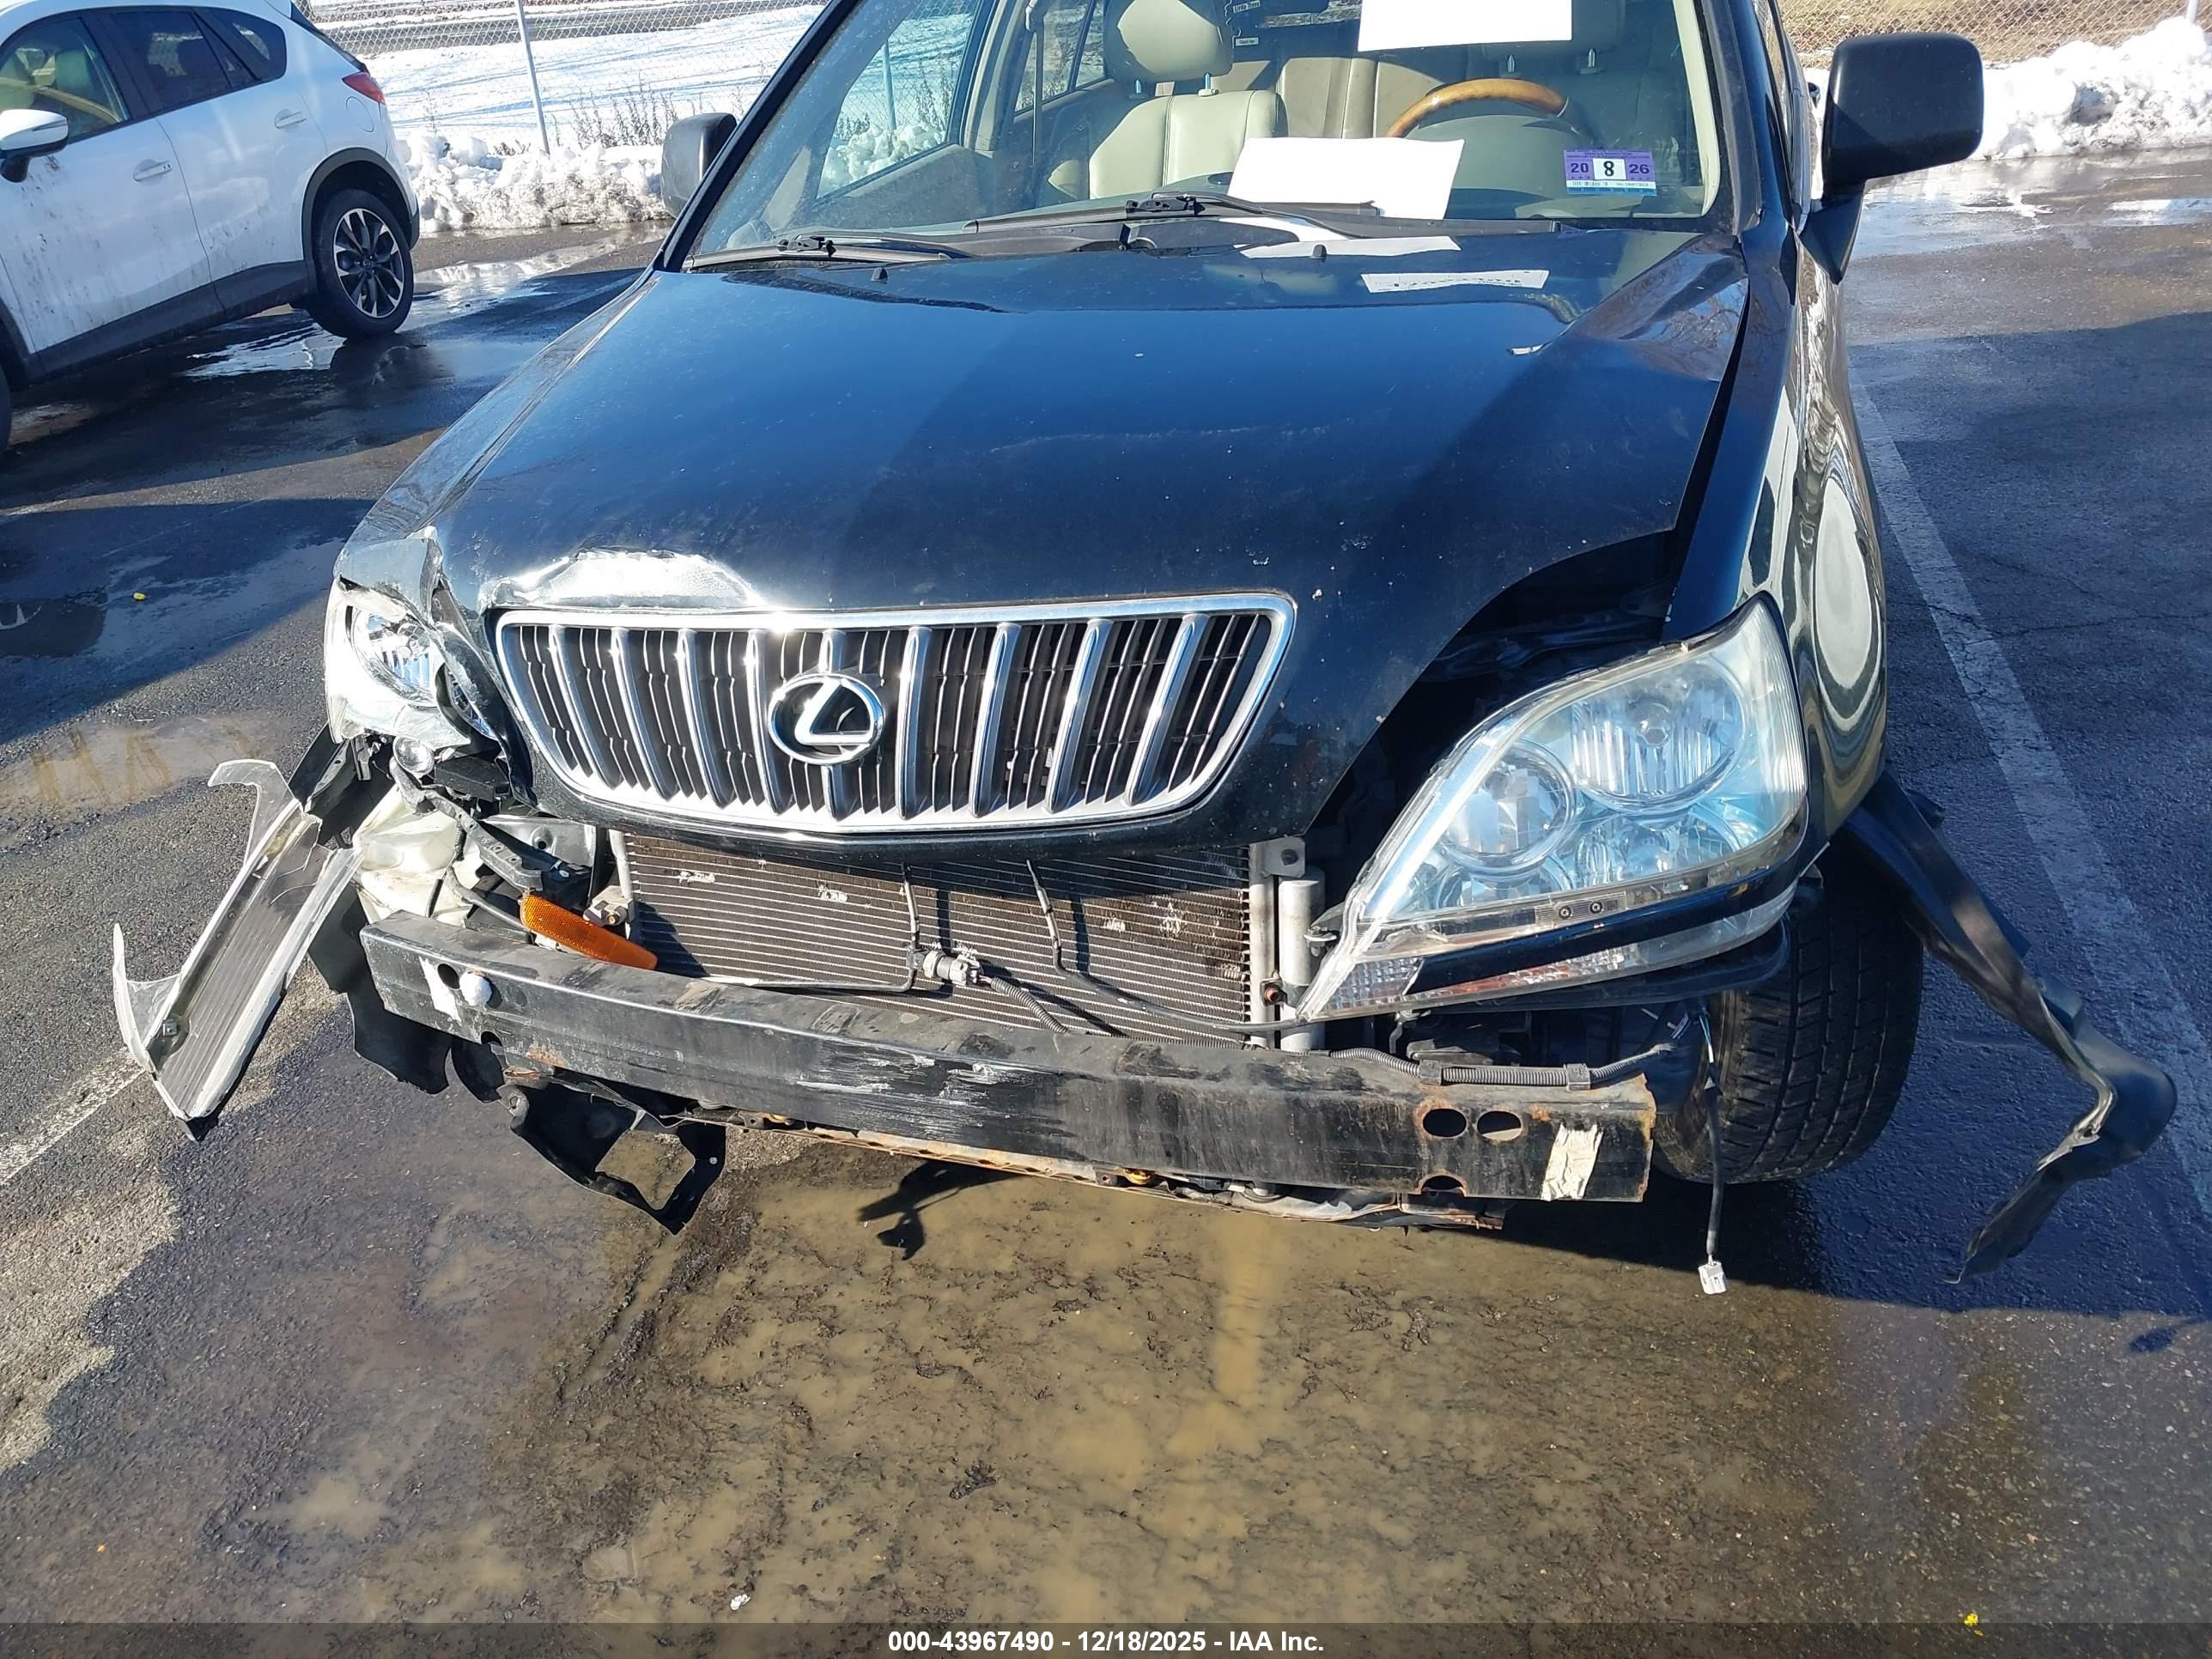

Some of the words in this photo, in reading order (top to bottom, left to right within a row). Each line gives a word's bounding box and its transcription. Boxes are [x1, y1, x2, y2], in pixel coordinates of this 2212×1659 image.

[1570, 162, 1589, 173] 20
[1603, 161, 1615, 177] 8
[1628, 163, 1650, 174] 26
